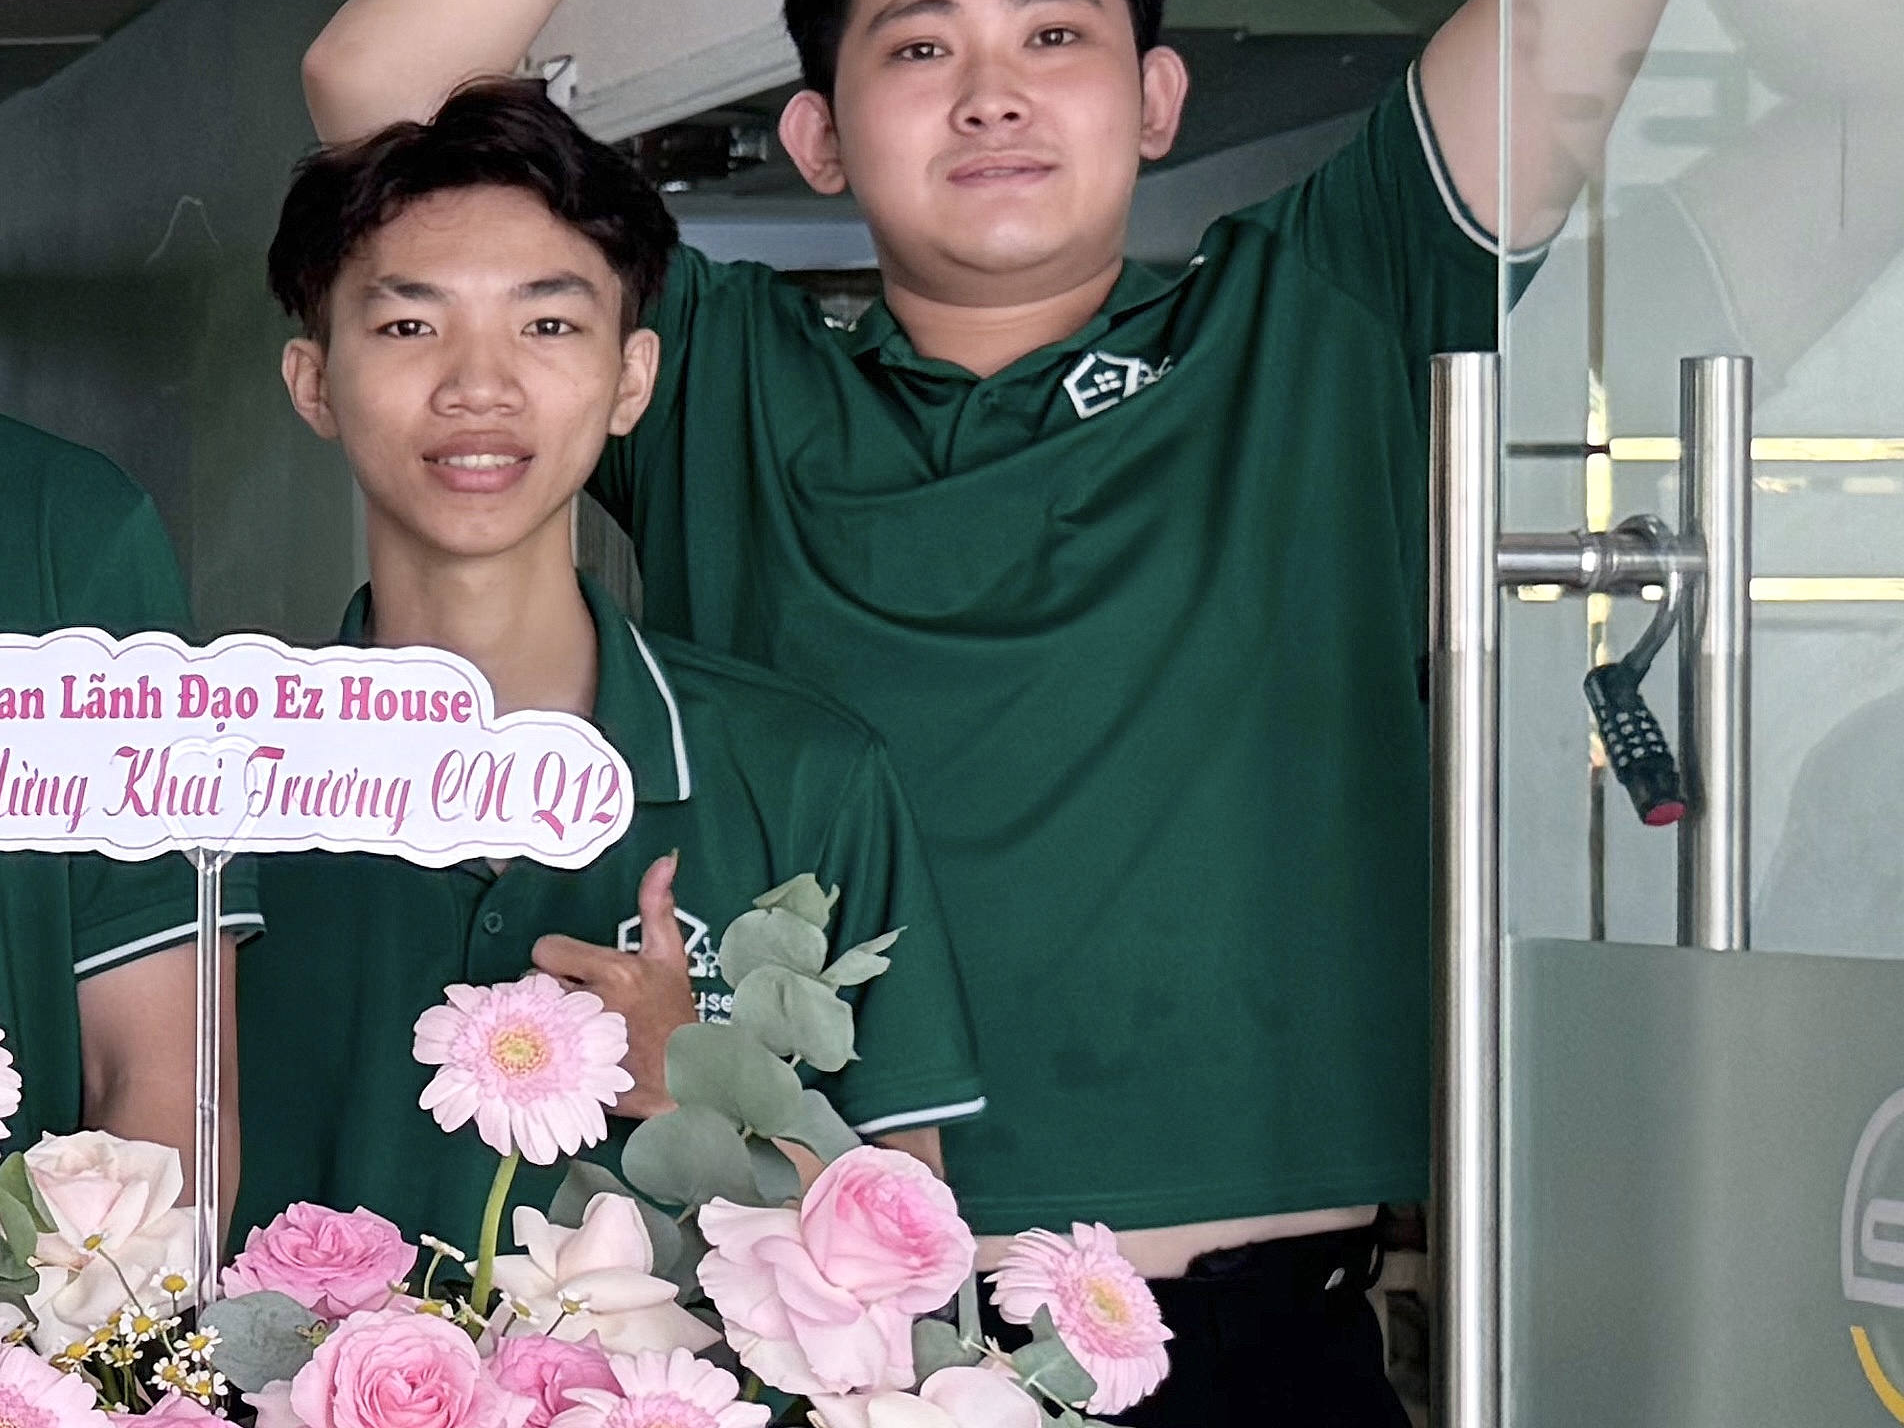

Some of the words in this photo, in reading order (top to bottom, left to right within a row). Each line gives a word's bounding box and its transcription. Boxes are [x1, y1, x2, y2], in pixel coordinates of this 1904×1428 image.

[61, 673, 162, 721] Lãnh
[177, 673, 258, 733] Đạo
[273, 675, 324, 722] Ez
[340, 675, 473, 724] House
[104, 744, 225, 819] Khai
[533, 747, 621, 840] Q12
